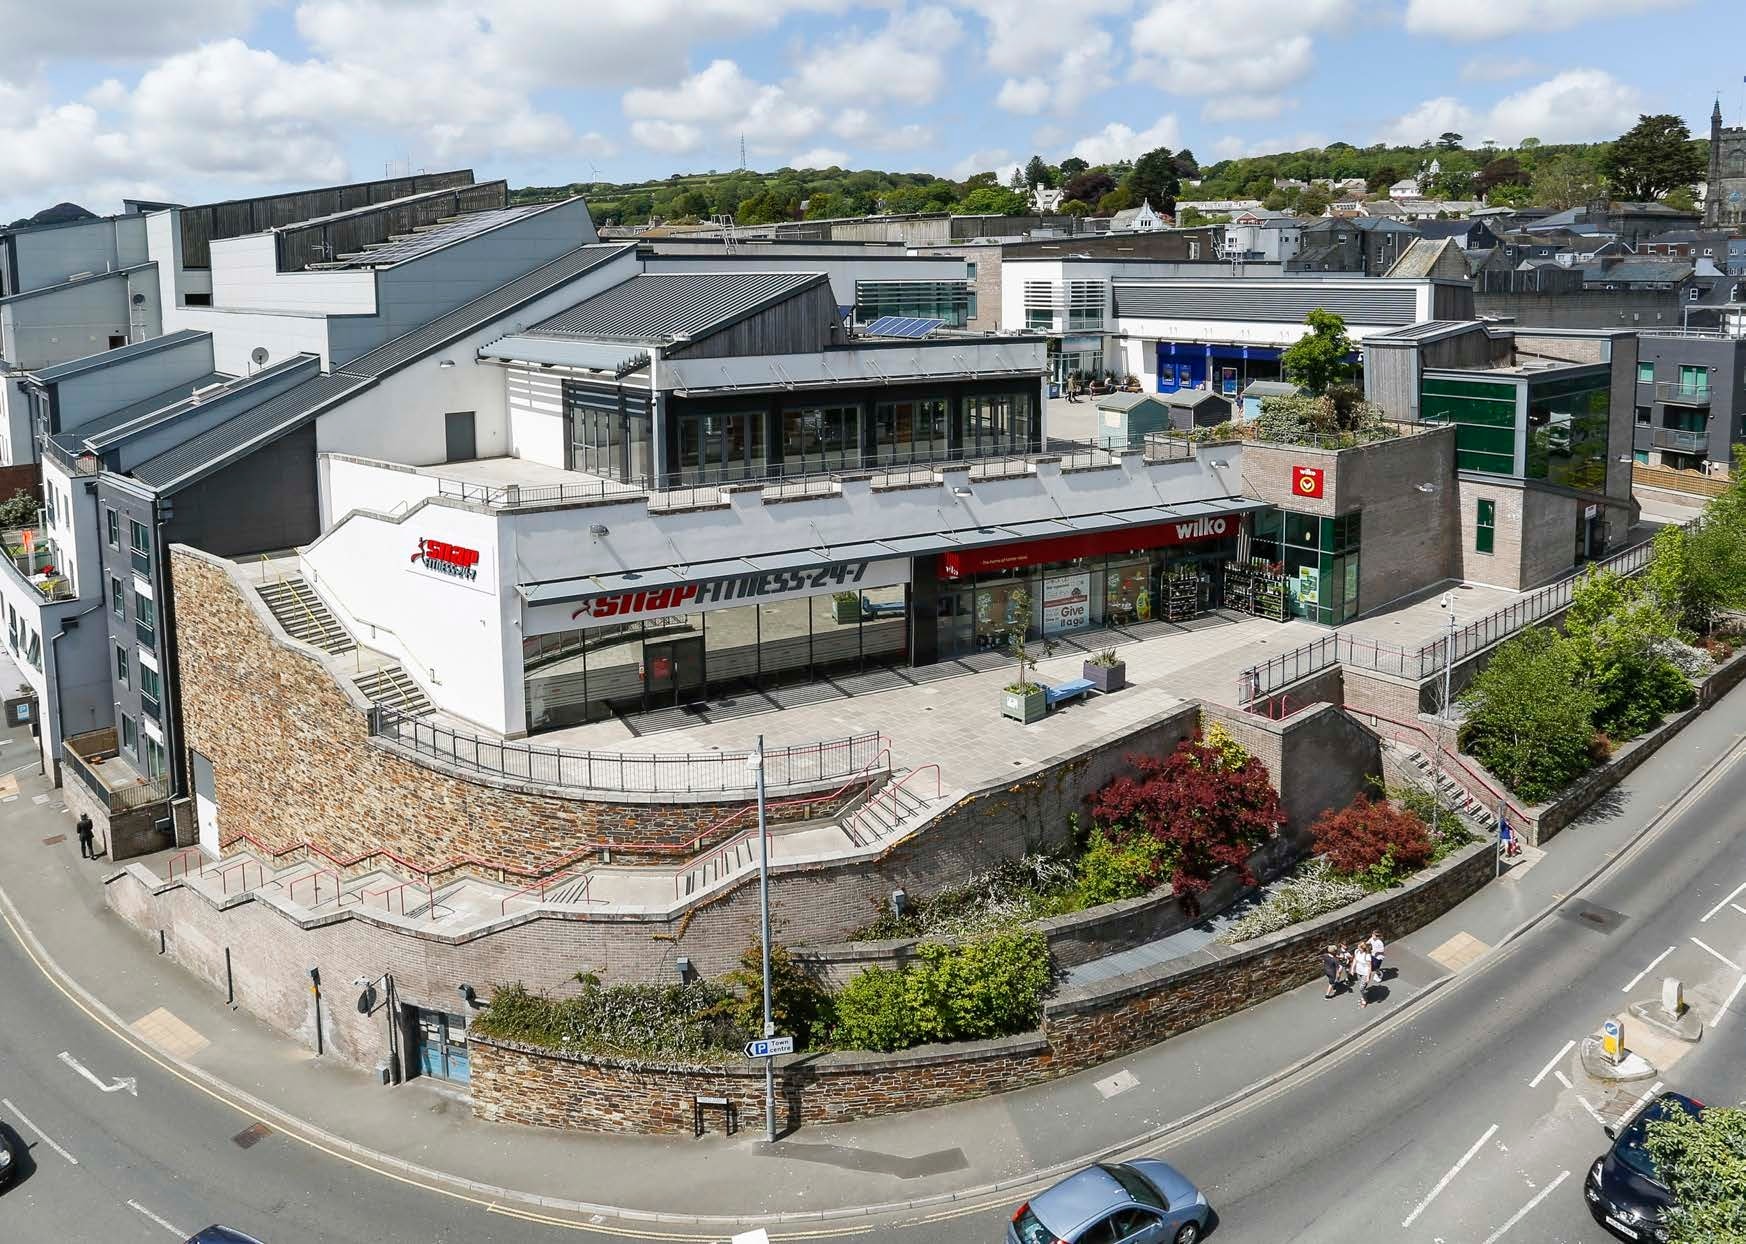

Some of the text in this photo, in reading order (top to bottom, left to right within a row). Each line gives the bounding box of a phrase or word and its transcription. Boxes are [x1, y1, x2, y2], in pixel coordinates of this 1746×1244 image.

[1176, 516, 1226, 540] wilko
[1061, 606, 1084, 617] Give
[1073, 617, 1084, 627] go
